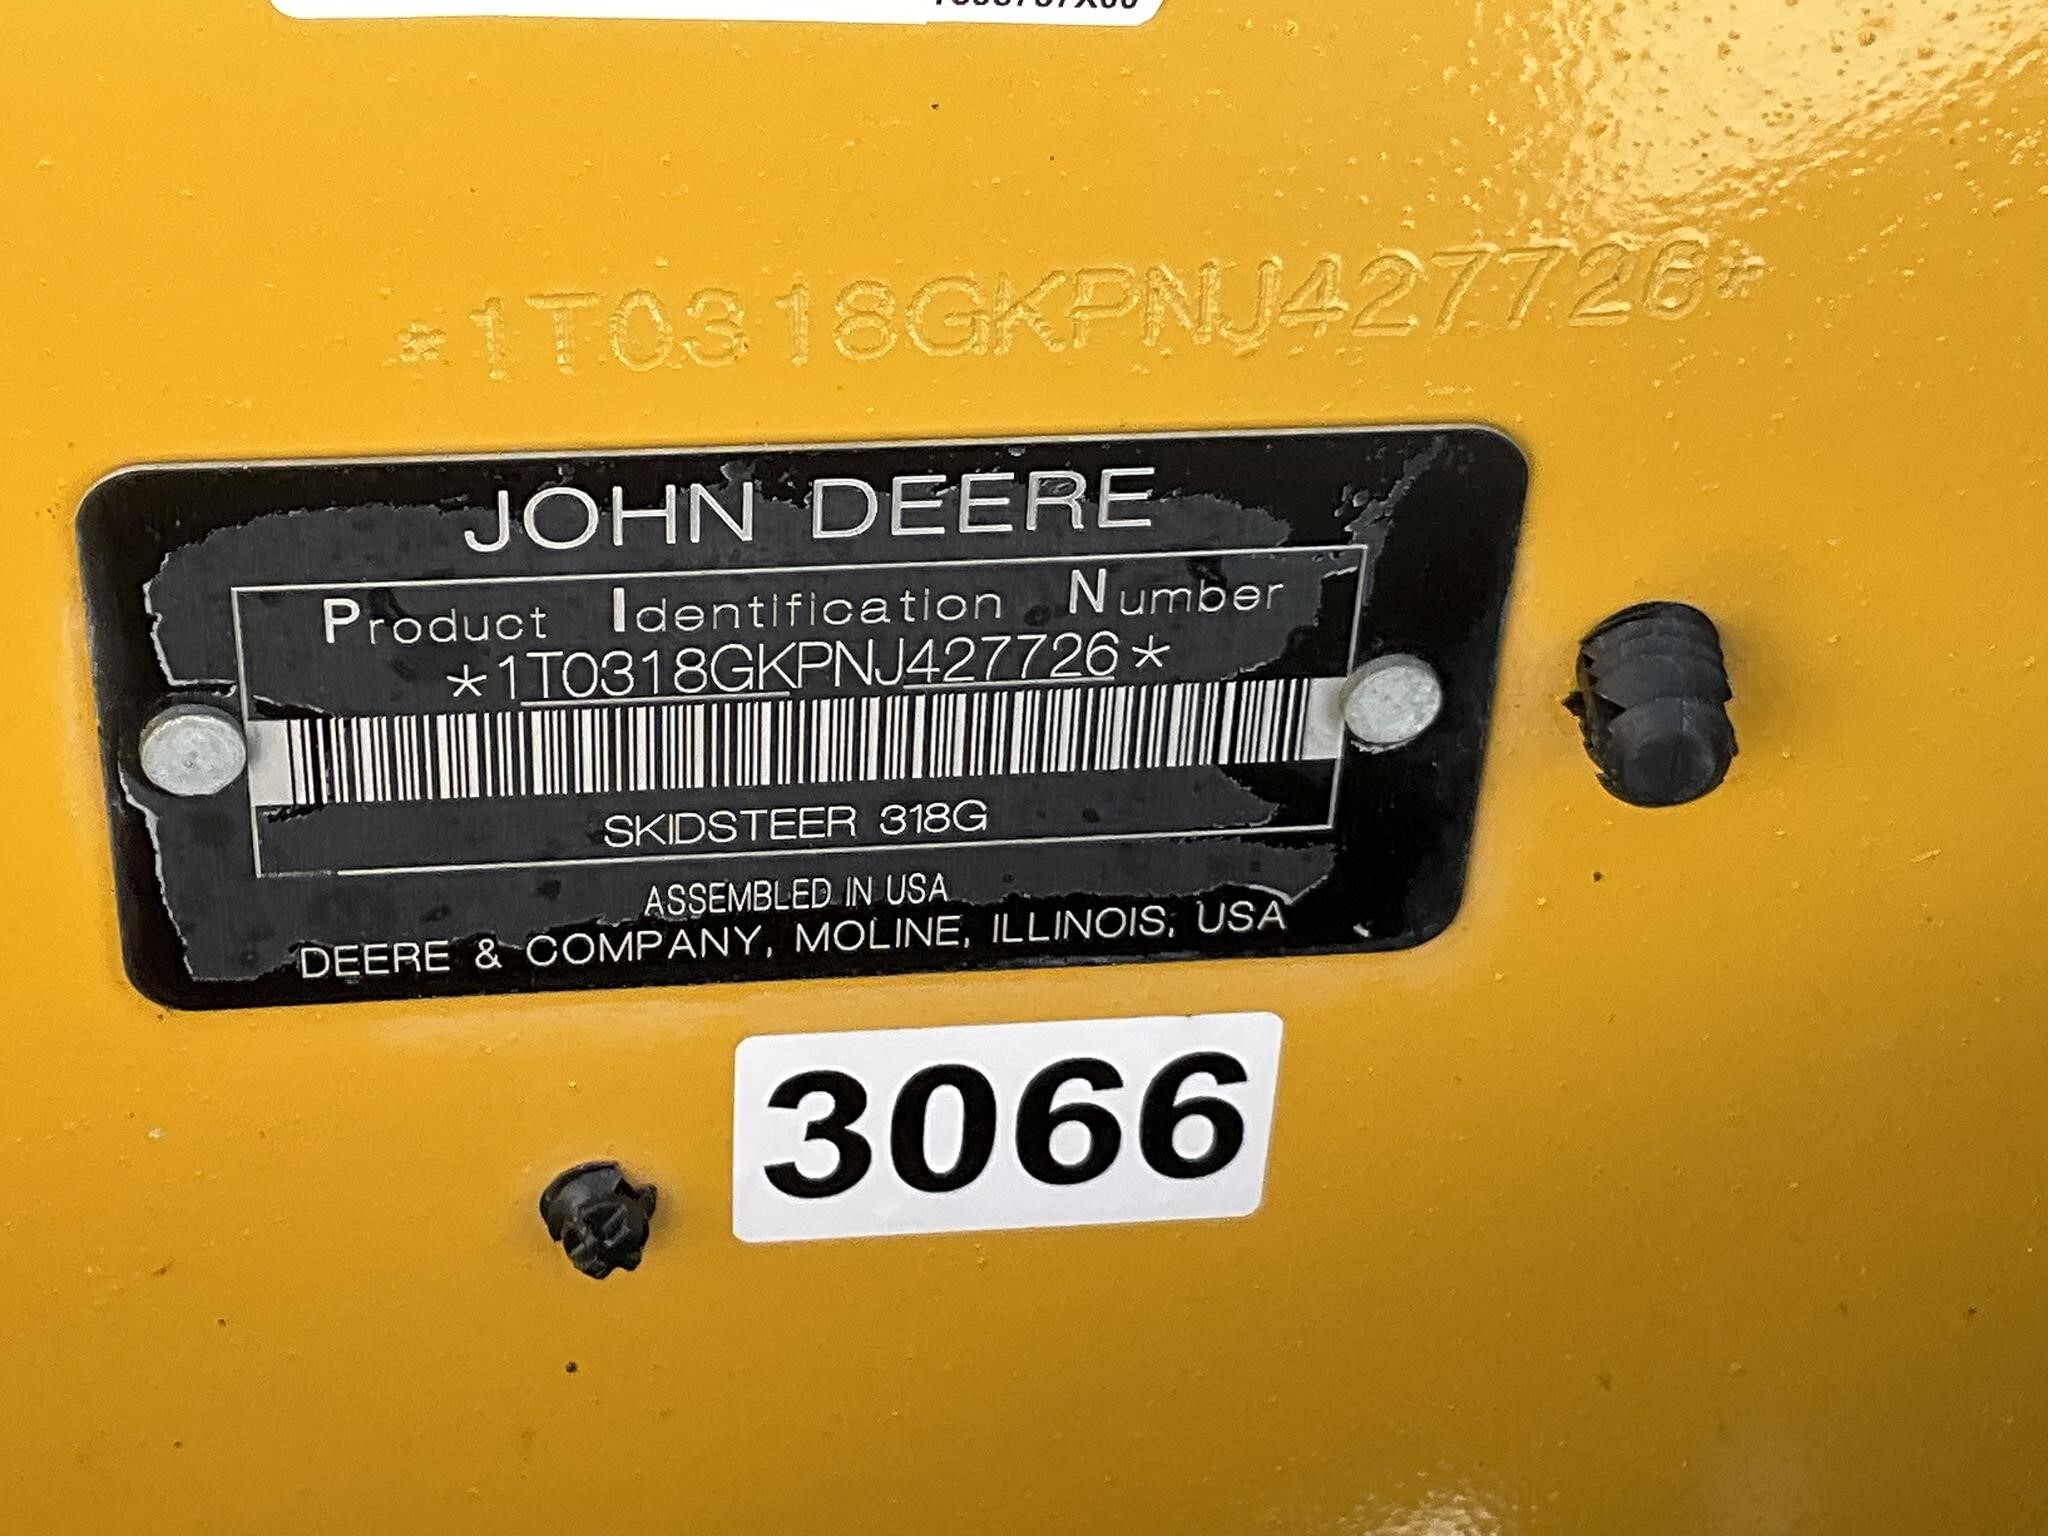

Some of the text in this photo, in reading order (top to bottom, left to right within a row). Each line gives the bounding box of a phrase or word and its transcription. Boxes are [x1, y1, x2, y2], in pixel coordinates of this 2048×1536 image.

[464, 467, 1156, 552] JOHN DEERE
[323, 568, 1284, 645] Product Identification Number
[603, 799, 988, 849] SKIDSTEER 318G
[644, 872, 948, 917] ASSEMBLED IN USA
[299, 940, 451, 980] DEERE
[474, 937, 503, 970] &
[526, 925, 773, 968] COMPANY,
[795, 914, 971, 953] MOLINE,
[1197, 900, 1288, 934] USA
[763, 1050, 1249, 1199] 3066
